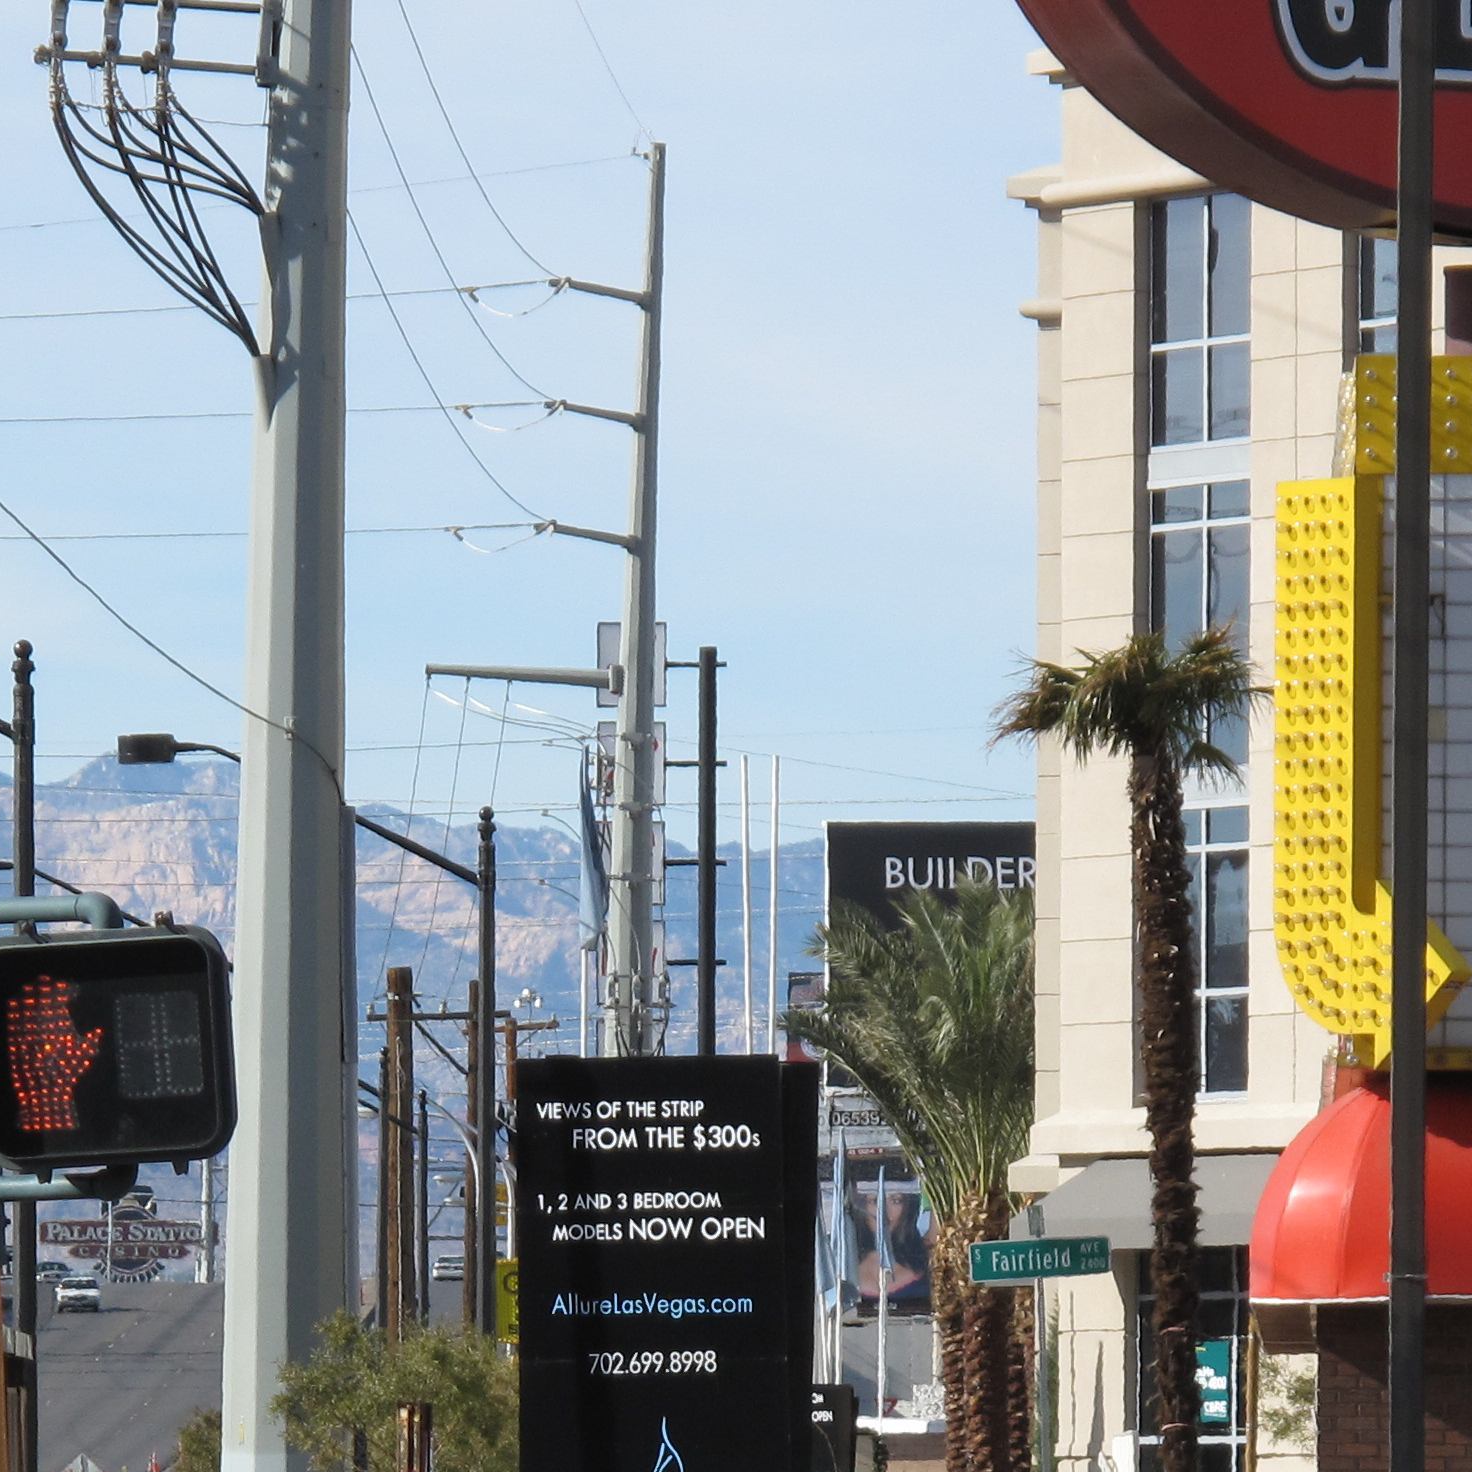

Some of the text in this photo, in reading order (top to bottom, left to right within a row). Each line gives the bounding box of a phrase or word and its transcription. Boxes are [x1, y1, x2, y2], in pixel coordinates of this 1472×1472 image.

[536, 1100, 704, 1120] VIEWS OF THE STRIP
[572, 1127, 638, 1149] FROM
[644, 1126, 685, 1148] THE
[558, 1193, 568, 1211] 2
[574, 1193, 612, 1211] AND
[617, 1193, 628, 1210] 3
[633, 1191, 722, 1209] BEDROOM
[552, 1216, 766, 1241] MODELS NOW OPEN
[992, 1246, 1071, 1272] Fairfield
[1080, 1241, 1100, 1253] AVE
[551, 1292, 753, 1319] AllureLasVegas.com
[589, 1350, 718, 1374] 702.699.8998
